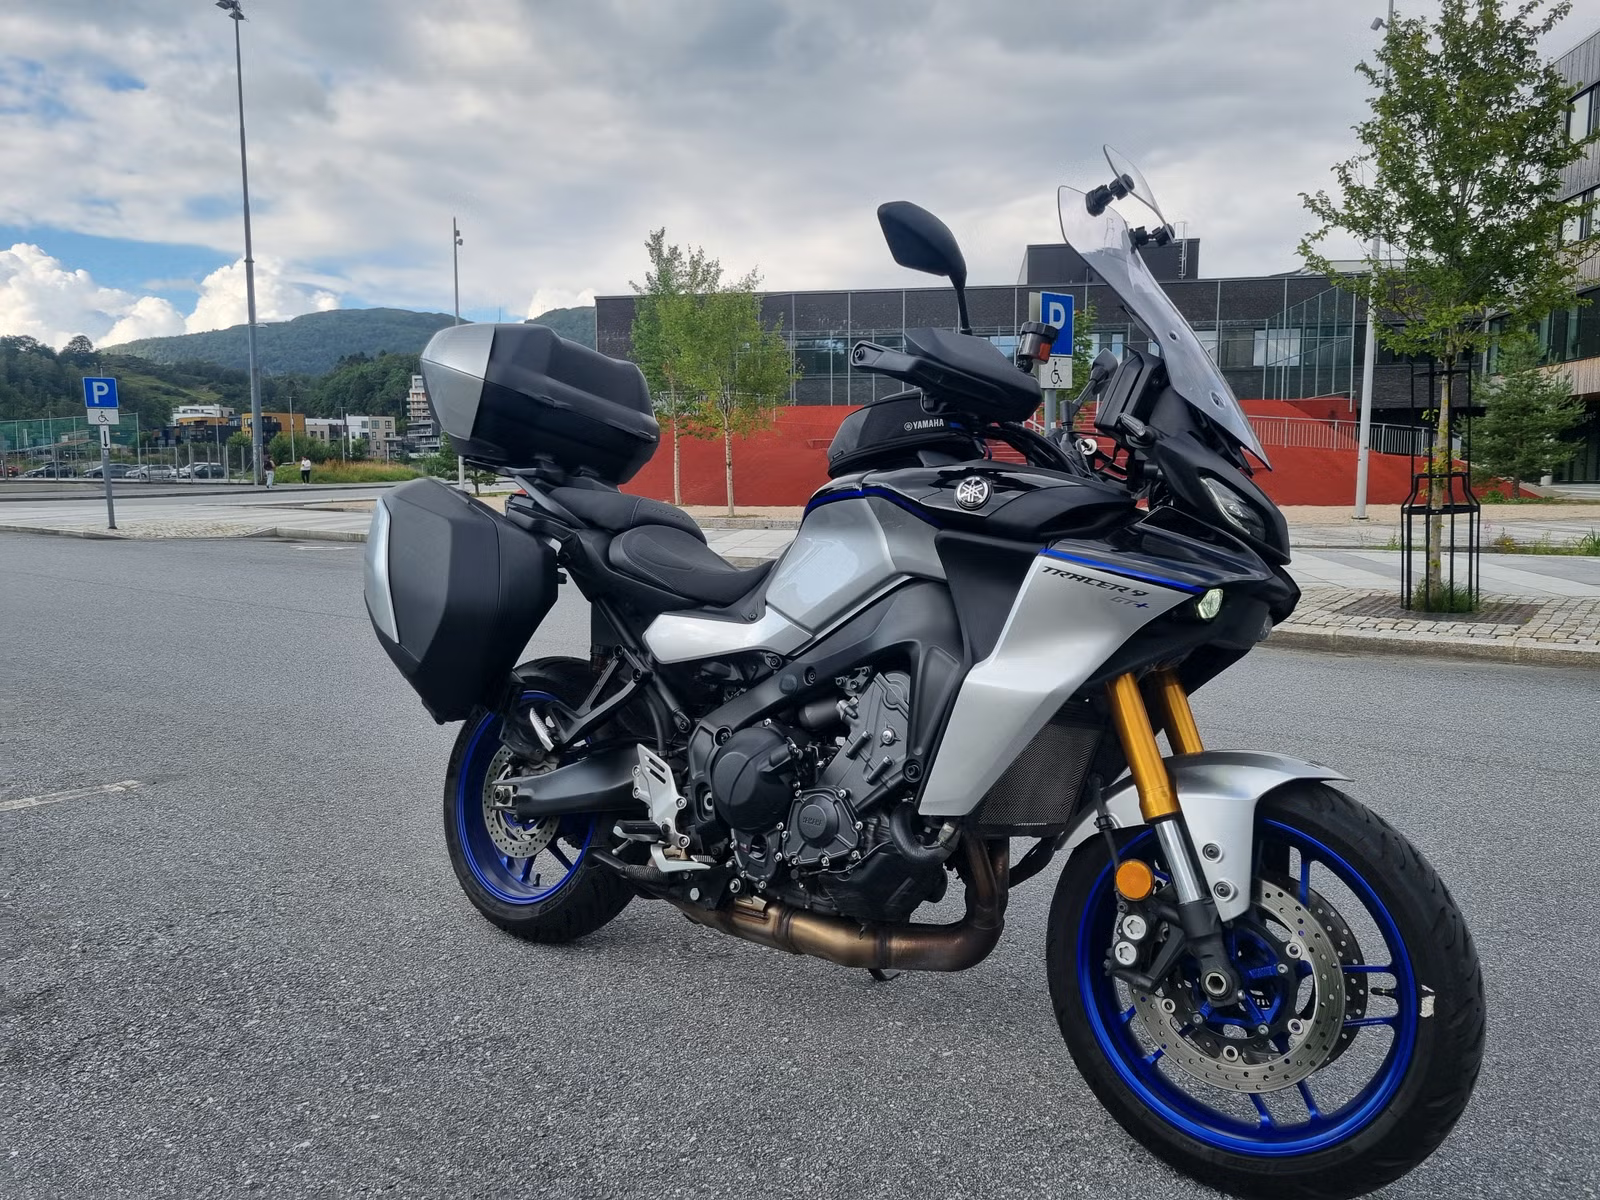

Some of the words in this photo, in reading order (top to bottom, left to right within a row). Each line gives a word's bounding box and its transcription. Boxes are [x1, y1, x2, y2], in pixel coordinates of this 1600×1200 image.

[92, 381, 109, 404] P
[912, 418, 945, 430] YAMAHA
[1042, 566, 1131, 593] TRACER
[1131, 589, 1150, 597] 9
